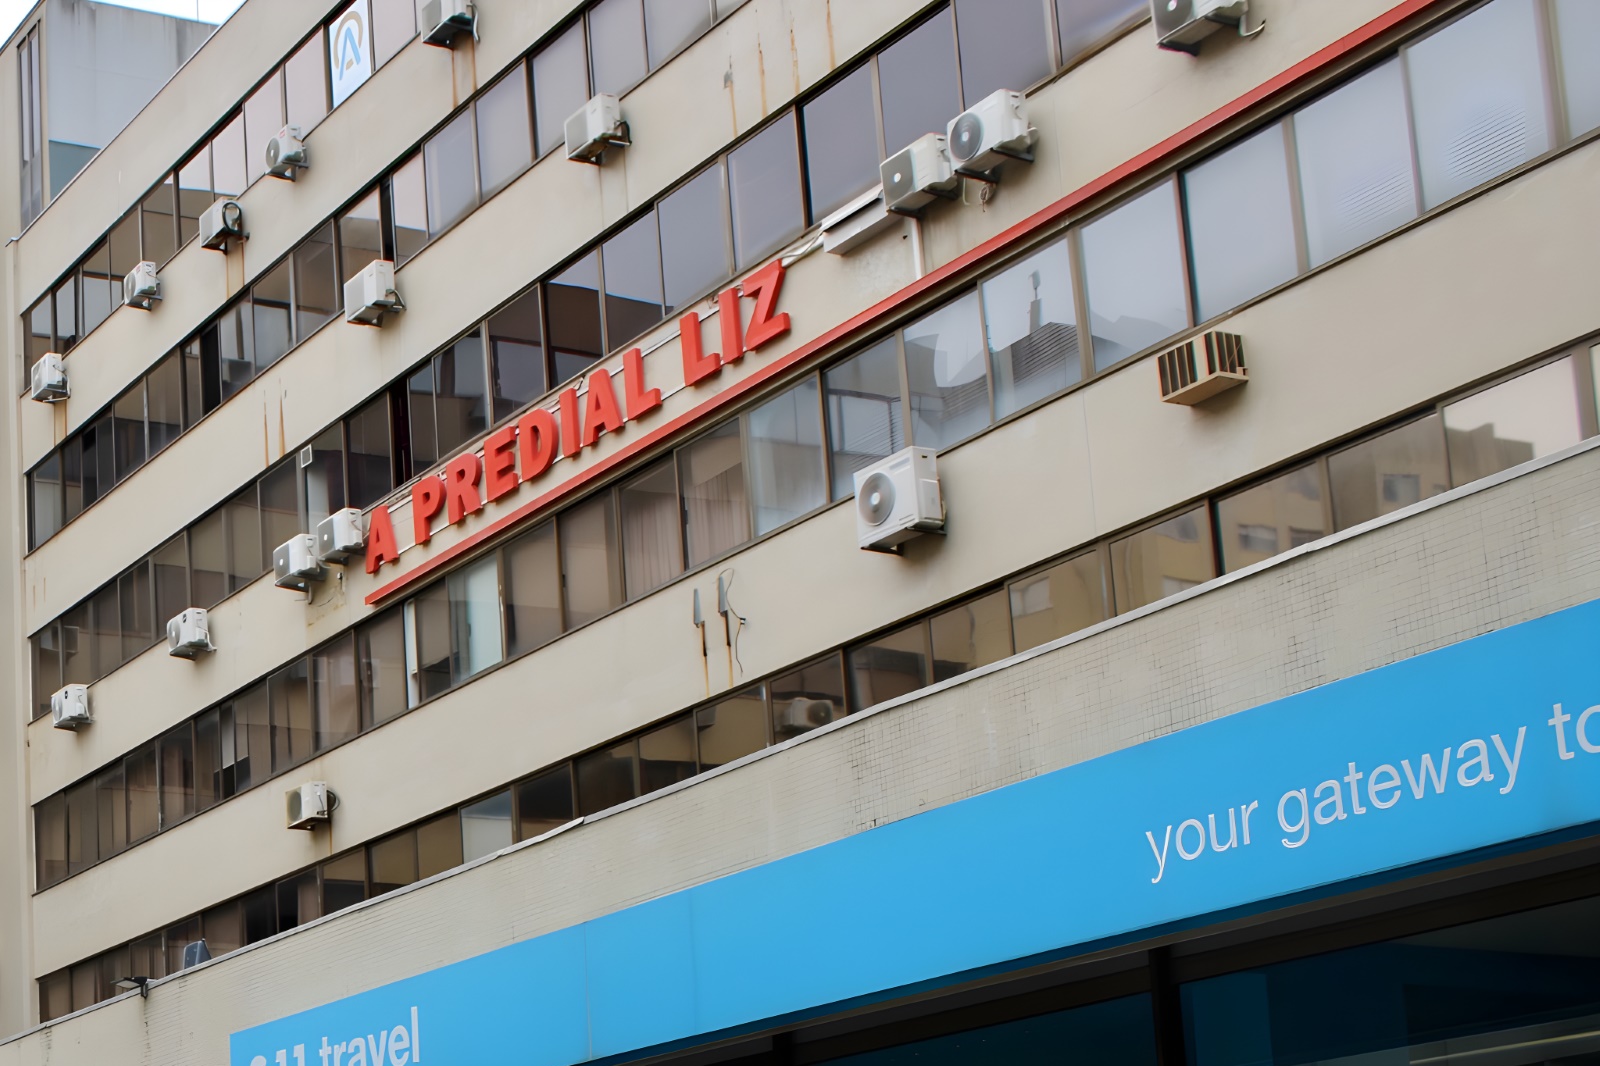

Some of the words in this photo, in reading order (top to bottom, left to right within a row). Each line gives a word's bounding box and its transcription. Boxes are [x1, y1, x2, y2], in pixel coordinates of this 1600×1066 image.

[365, 504, 399, 574] A
[411, 347, 663, 546] PREDIAL
[679, 258, 791, 387] LIZ
[1145, 799, 1259, 884] your
[1276, 725, 1527, 849] gateway
